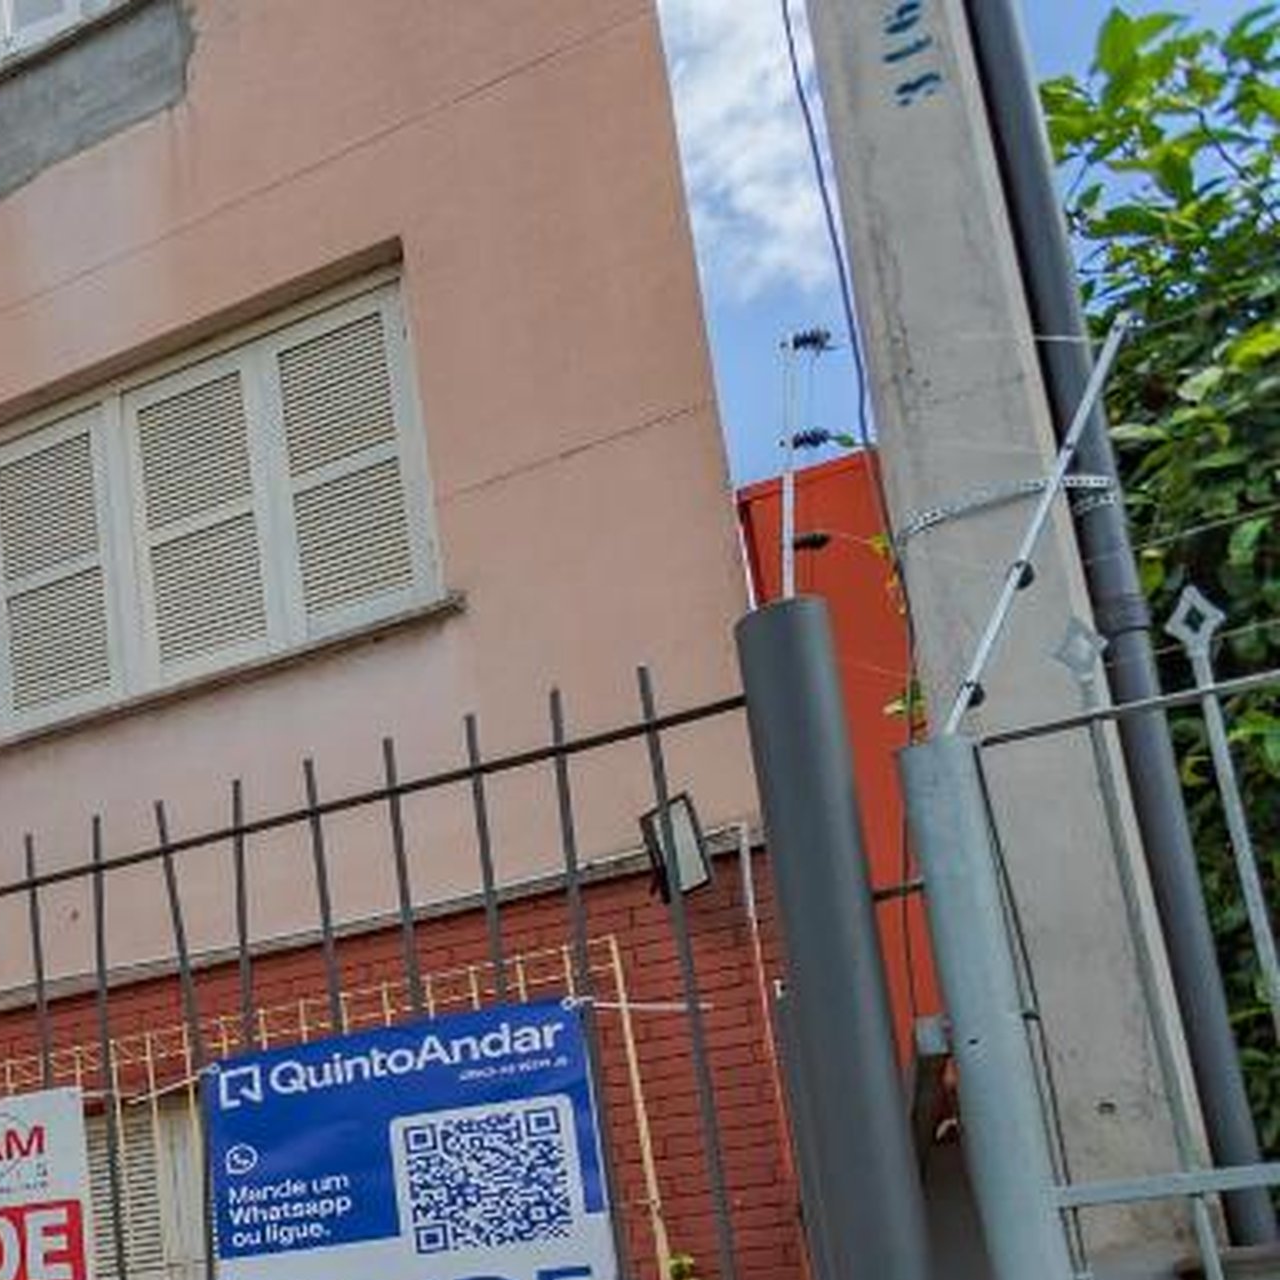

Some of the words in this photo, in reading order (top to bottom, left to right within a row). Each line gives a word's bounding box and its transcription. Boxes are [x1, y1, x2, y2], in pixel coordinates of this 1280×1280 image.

[269, 1021, 564, 1094] QuintoAndar
[312, 1174, 349, 1195] um
[232, 1230, 261, 1248] ou
